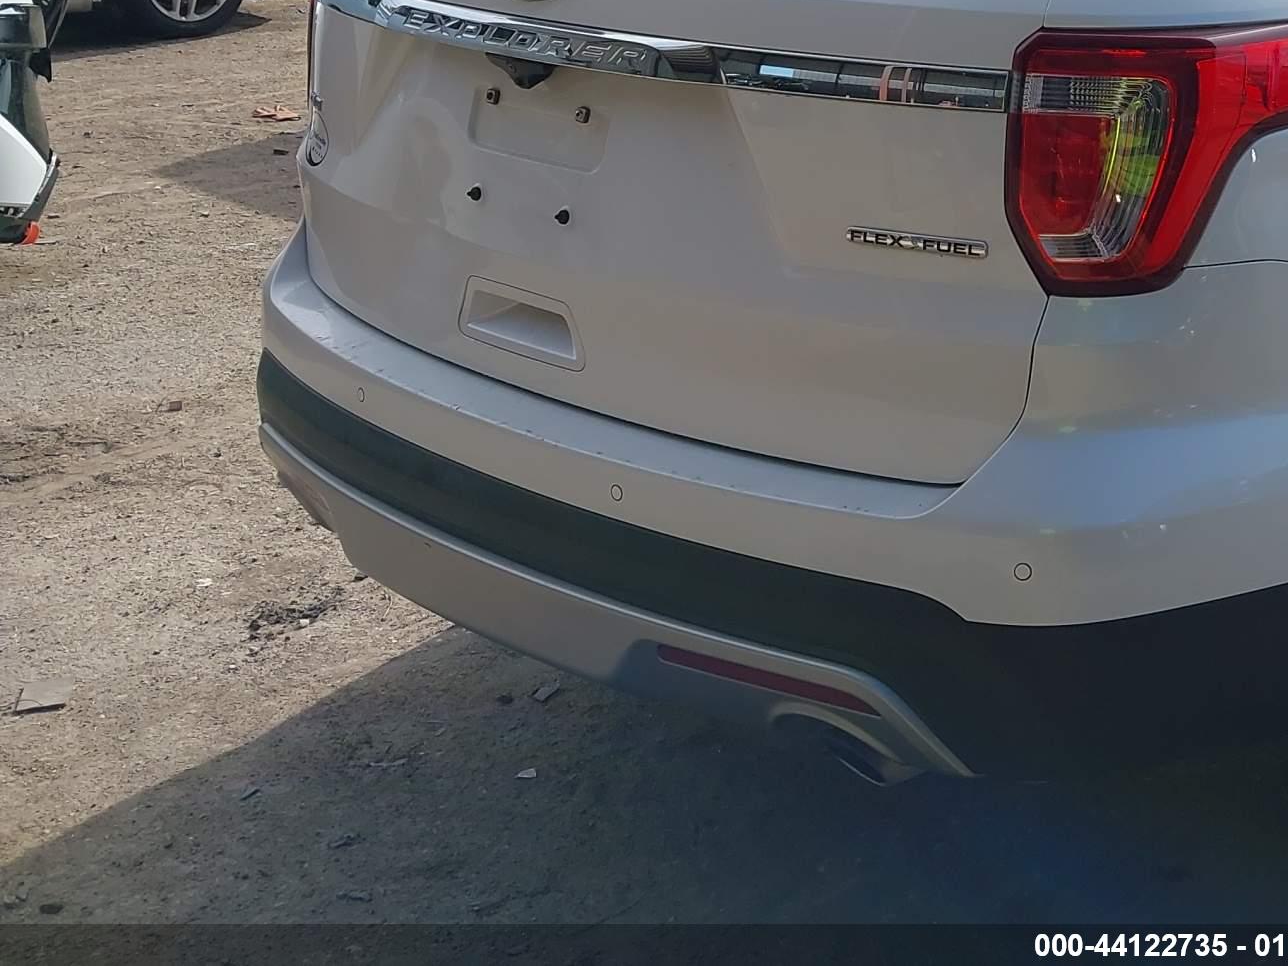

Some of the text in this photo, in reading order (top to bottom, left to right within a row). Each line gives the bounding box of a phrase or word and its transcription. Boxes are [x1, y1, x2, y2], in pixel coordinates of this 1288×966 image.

[402, 9, 648, 75] EXPLORER
[850, 230, 981, 256] FLEX FUEL
